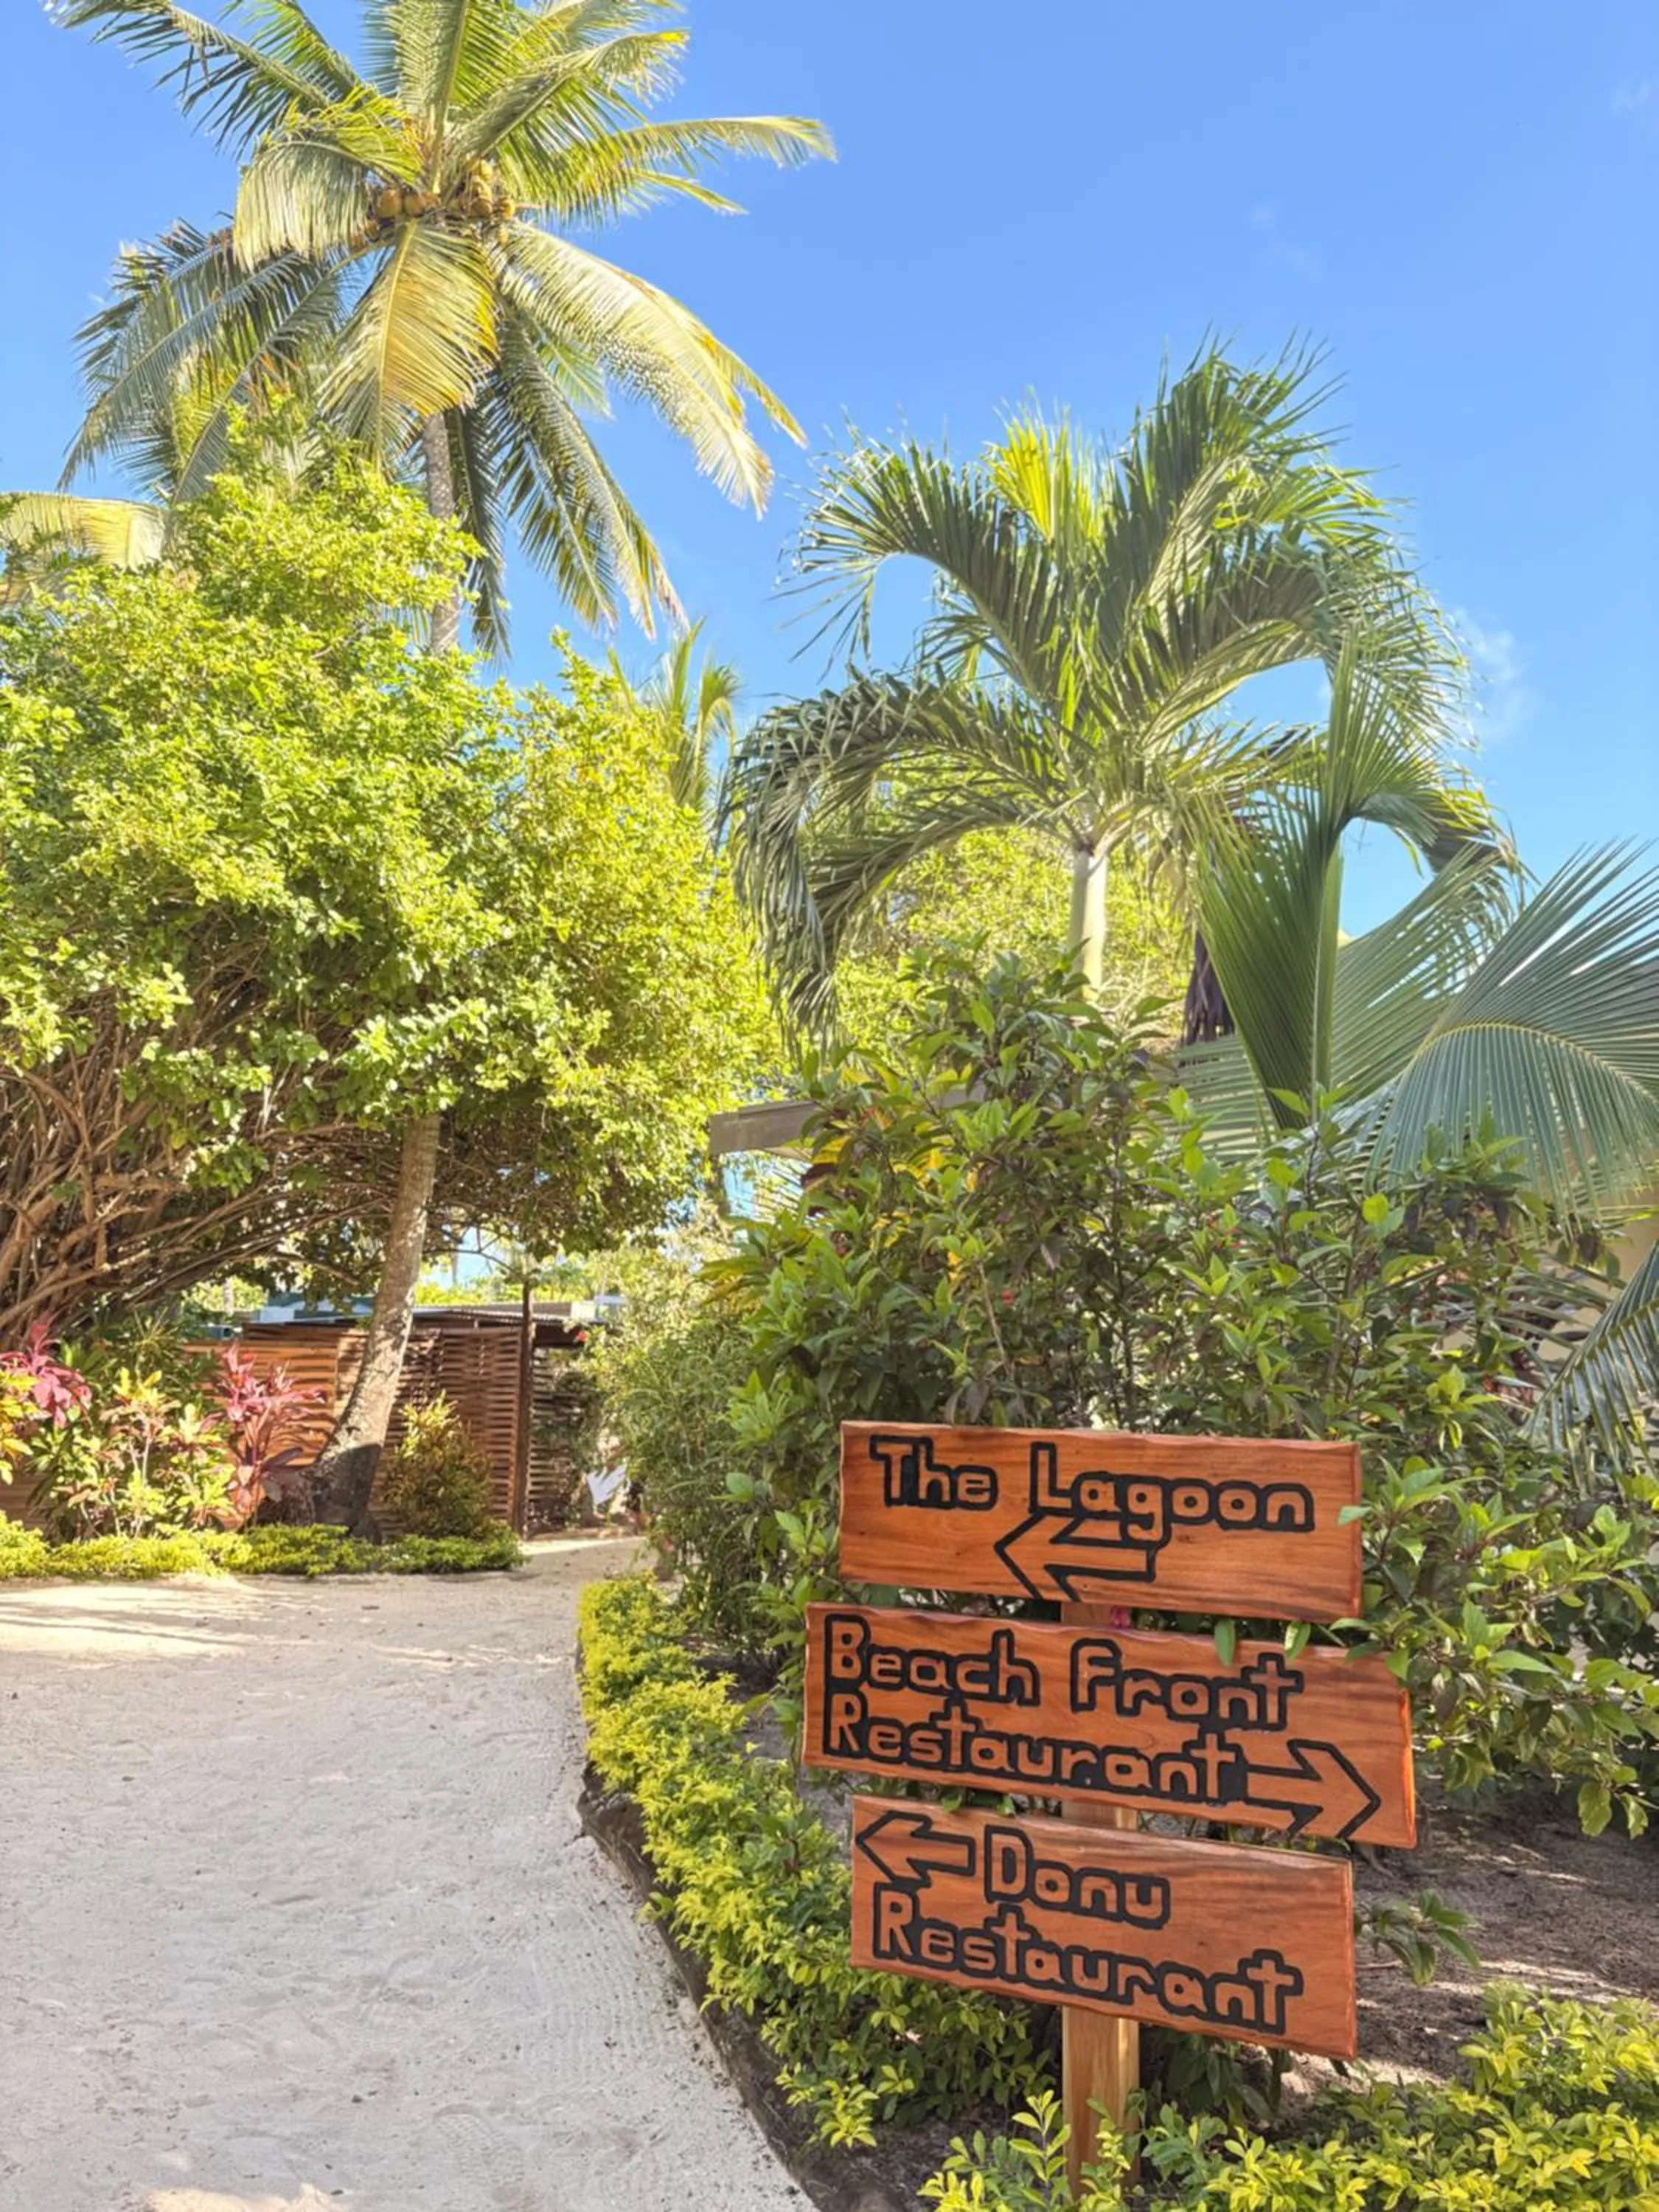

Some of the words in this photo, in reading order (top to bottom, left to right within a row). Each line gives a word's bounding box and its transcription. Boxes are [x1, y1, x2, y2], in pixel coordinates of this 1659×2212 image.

[870, 1436, 998, 1509] The
[1029, 1442, 1315, 1548] Lagoon
[824, 1613, 1040, 1706] Beach
[1070, 1638, 1304, 1732] Front
[824, 1683, 1249, 1806] Restaurant
[873, 1882, 1304, 2035] Restaurant
